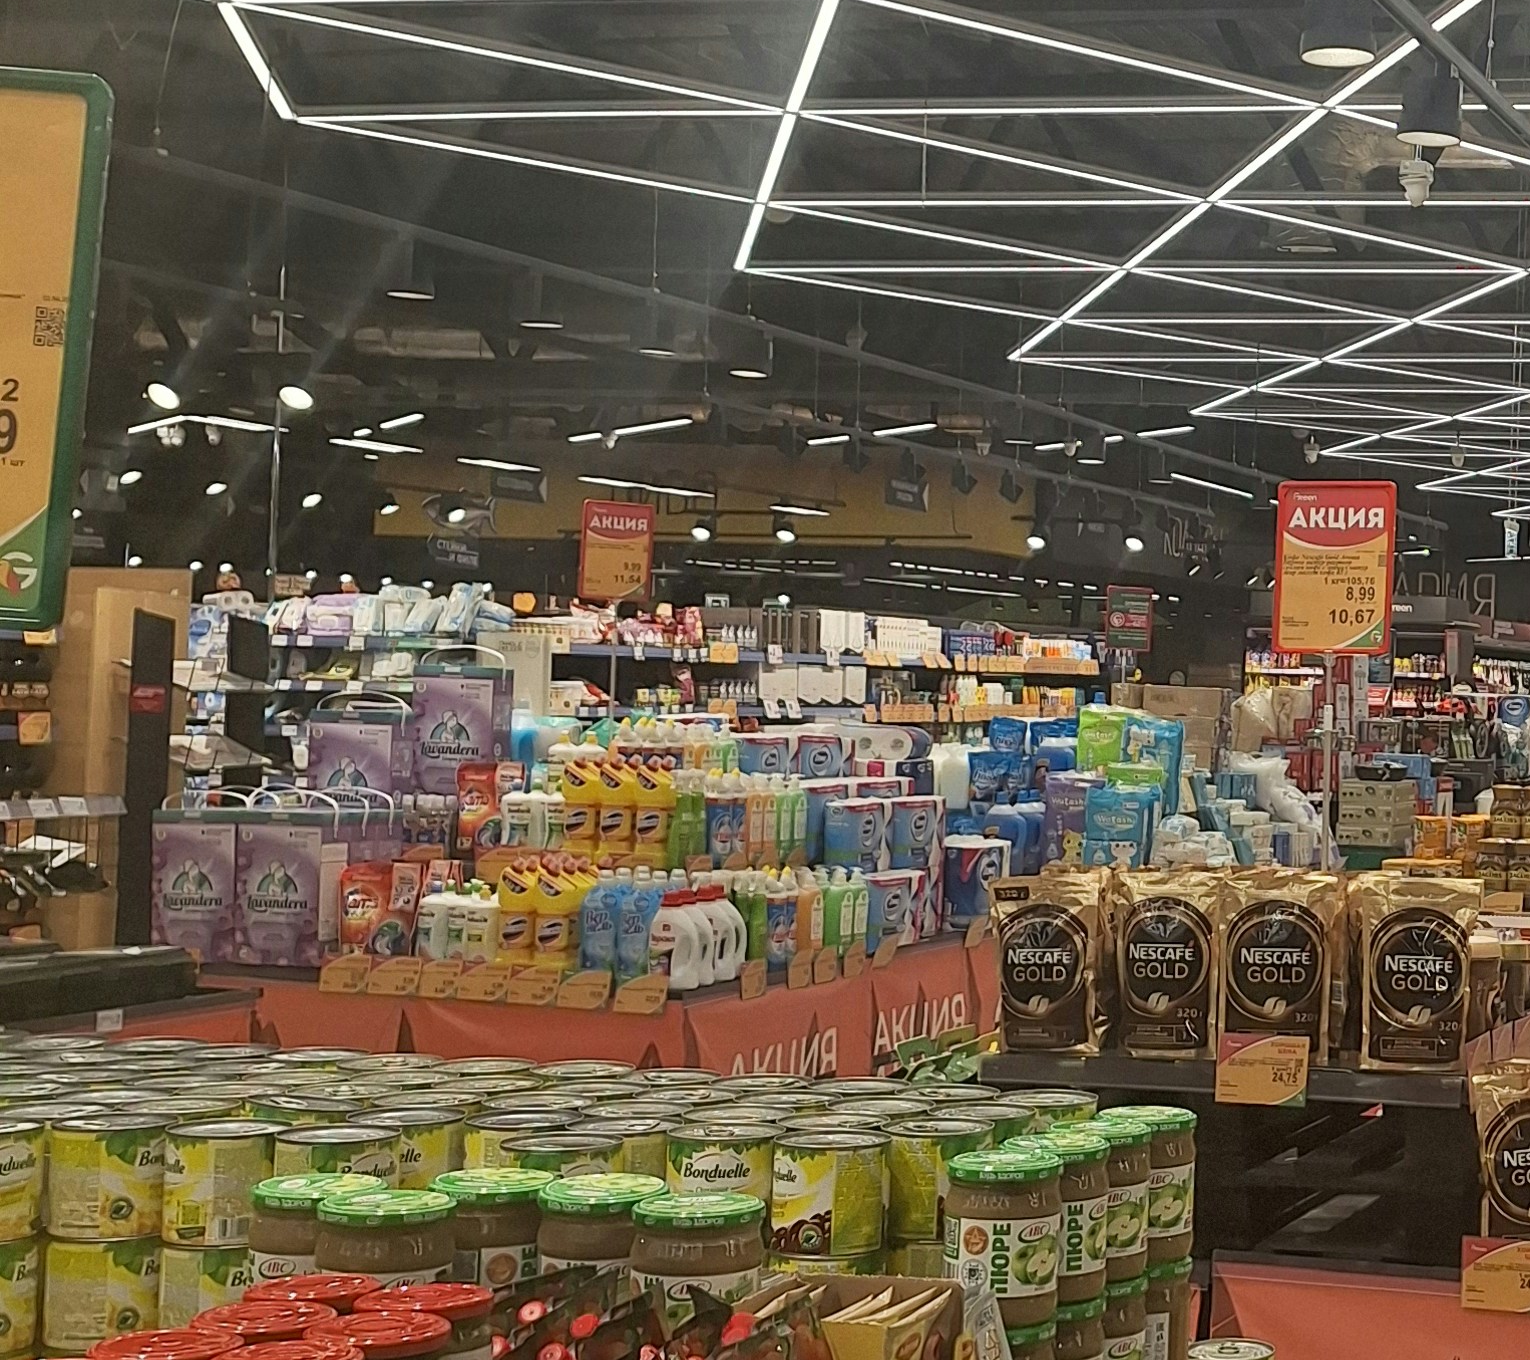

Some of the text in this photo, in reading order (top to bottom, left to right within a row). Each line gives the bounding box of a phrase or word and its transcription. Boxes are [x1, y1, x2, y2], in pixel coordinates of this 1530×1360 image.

[588, 513, 649, 533] АКЦИЯ
[1288, 506, 1386, 531] АКЦИЯ
[1345, 586, 1376, 604] 8,99
[1392, 603, 1413, 613] reen
[1328, 608, 1376, 628] 10,67
[420, 741, 480, 758] Lavandera
[162, 893, 223, 911] Lavandera
[247, 894, 308, 913] Lavandera
[1012, 965, 1067, 982] GOLD
[1133, 961, 1189, 979] GOLD
[1246, 966, 1307, 984] GOLD
[1391, 973, 1449, 992] GOLD
[1176, 1007, 1198, 1018] 320
[873, 993, 966, 1056] АКЦИЯ
[1438, 1020, 1458, 1032] 320
[731, 1026, 838, 1078] АКЦИЯ
[1271, 1070, 1299, 1085] 24,75
[683, 1161, 751, 1183] Bonduelle
[1065, 1203, 1084, 1273] ПЮРЕ
[989, 1222, 1012, 1295] ПЮРЕ
